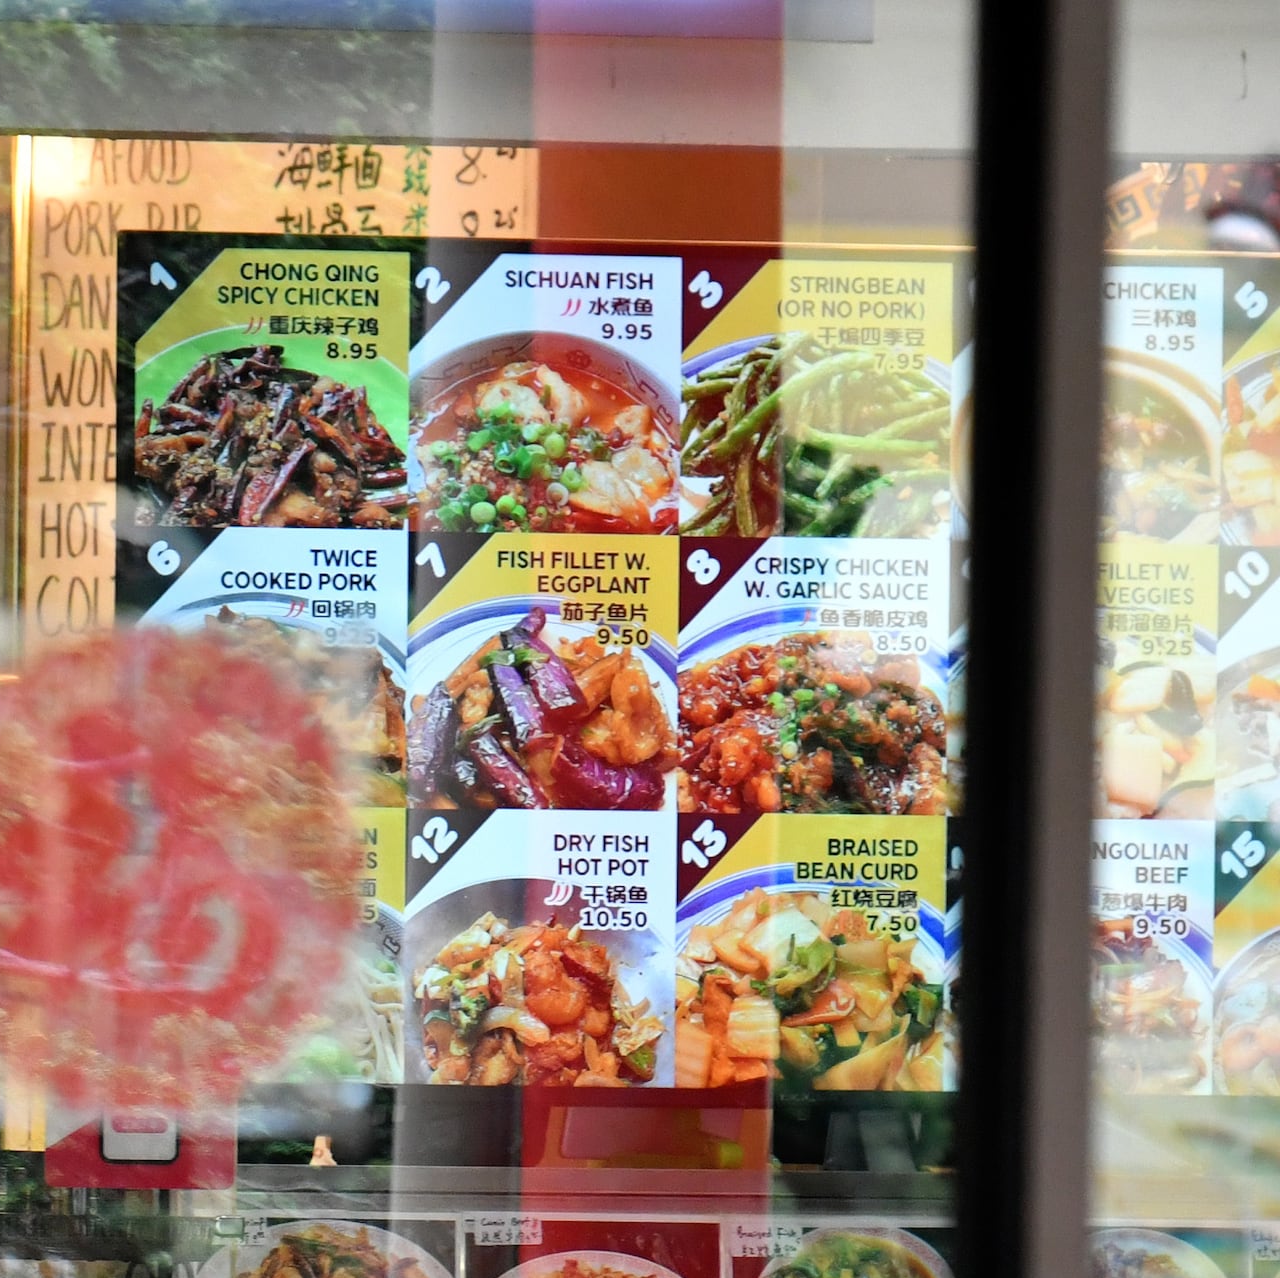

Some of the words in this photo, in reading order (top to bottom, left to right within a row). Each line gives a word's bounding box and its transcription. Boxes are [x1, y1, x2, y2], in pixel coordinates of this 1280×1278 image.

[240, 263, 319, 282] CHONG
[325, 264, 379, 283] QING
[504, 270, 600, 289] SICHUAN
[606, 272, 654, 290] FISH
[414, 266, 452, 305] 2
[687, 270, 724, 310] 3
[789, 276, 926, 296] STRINGBEAN
[1103, 281, 1198, 301] CHICKEN
[39, 271, 111, 332] DAN
[217, 285, 279, 305] SPICY
[284, 287, 379, 307] CHICKEN
[1234, 280, 1270, 320] 5
[588, 297, 654, 317] 水煮鱼
[776, 299, 815, 319] (OR
[821, 300, 853, 319] NO
[858, 301, 926, 321] PORK)
[268, 315, 379, 336] 重庆辣子鸡
[1131, 308, 1197, 329] 三杯鸡
[601, 323, 653, 341] 9.95
[326, 342, 378, 360] 8.95
[1145, 334, 1196, 352] 8.95
[874, 353, 925, 371] 7.95
[40, 501, 107, 559] HOT
[147, 539, 181, 576] 6
[309, 549, 378, 568] TWICE
[497, 551, 545, 569] FISH
[551, 551, 619, 570] FILLET
[625, 553, 650, 571] W.
[686, 548, 721, 586] 8
[754, 556, 830, 576] CRISPY
[835, 558, 930, 577] CHICKEN
[220, 570, 313, 590] COOKED
[318, 573, 377, 592] PORK
[1097, 562, 1165, 581] FILLET
[1169, 563, 1195, 581] W.
[1223, 550, 1271, 600] 10
[537, 575, 651, 595] EGGPLANT
[744, 580, 771, 599] W.
[776, 581, 853, 600] GARLIC
[858, 582, 930, 601] SAUCE
[1103, 587, 1195, 605] VEGGIES
[311, 600, 377, 619] 回锅肉
[561, 602, 649, 622] 茄子鱼片
[819, 608, 929, 629] 鱼香脆皮鸡
[597, 628, 649, 646] 9.50
[876, 635, 928, 653] 8.50
[1141, 639, 1193, 656] 9.25
[410, 816, 460, 865] 12
[553, 834, 597, 853] DRY
[601, 836, 649, 853] FISH
[681, 818, 728, 869] 13
[827, 838, 919, 857] BRAISED
[1220, 829, 1267, 879] 15
[558, 858, 603, 876] HOT
[608, 859, 650, 877] POT
[796, 862, 855, 881] BEAN
[860, 863, 919, 881] CURD
[1135, 866, 1189, 884] BEEF
[583, 885, 649, 905] 干锅鱼
[831, 888, 918, 910] 红烧豆腐
[1100, 892, 1188, 912] 葱爆牛肉
[582, 910, 648, 928] 10.50
[866, 914, 918, 932] 7.50
[1135, 918, 1188, 936] 9.50
